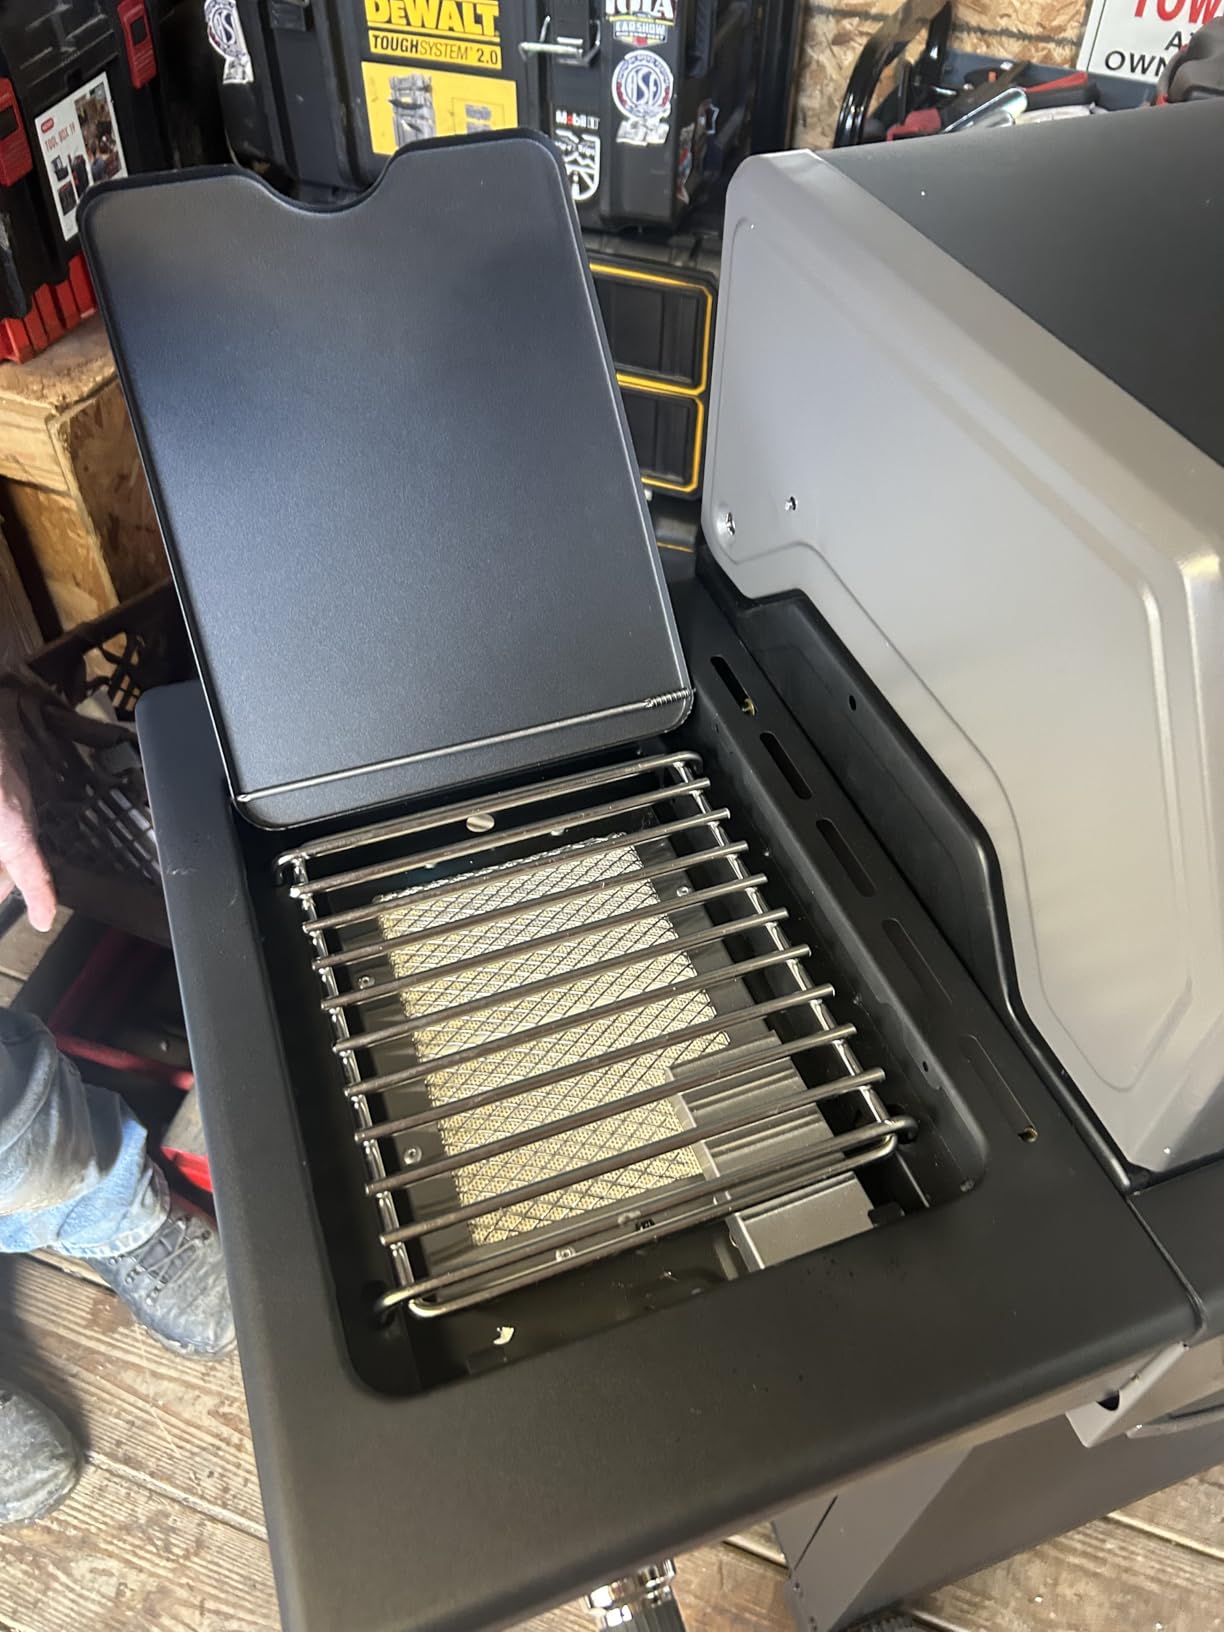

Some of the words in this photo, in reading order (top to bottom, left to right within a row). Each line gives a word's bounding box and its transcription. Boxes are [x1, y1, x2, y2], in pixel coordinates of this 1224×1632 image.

[476, 48, 498, 65] 2.0
[45, 135, 60, 153] TOOL
[59, 128, 70, 145] BOX
